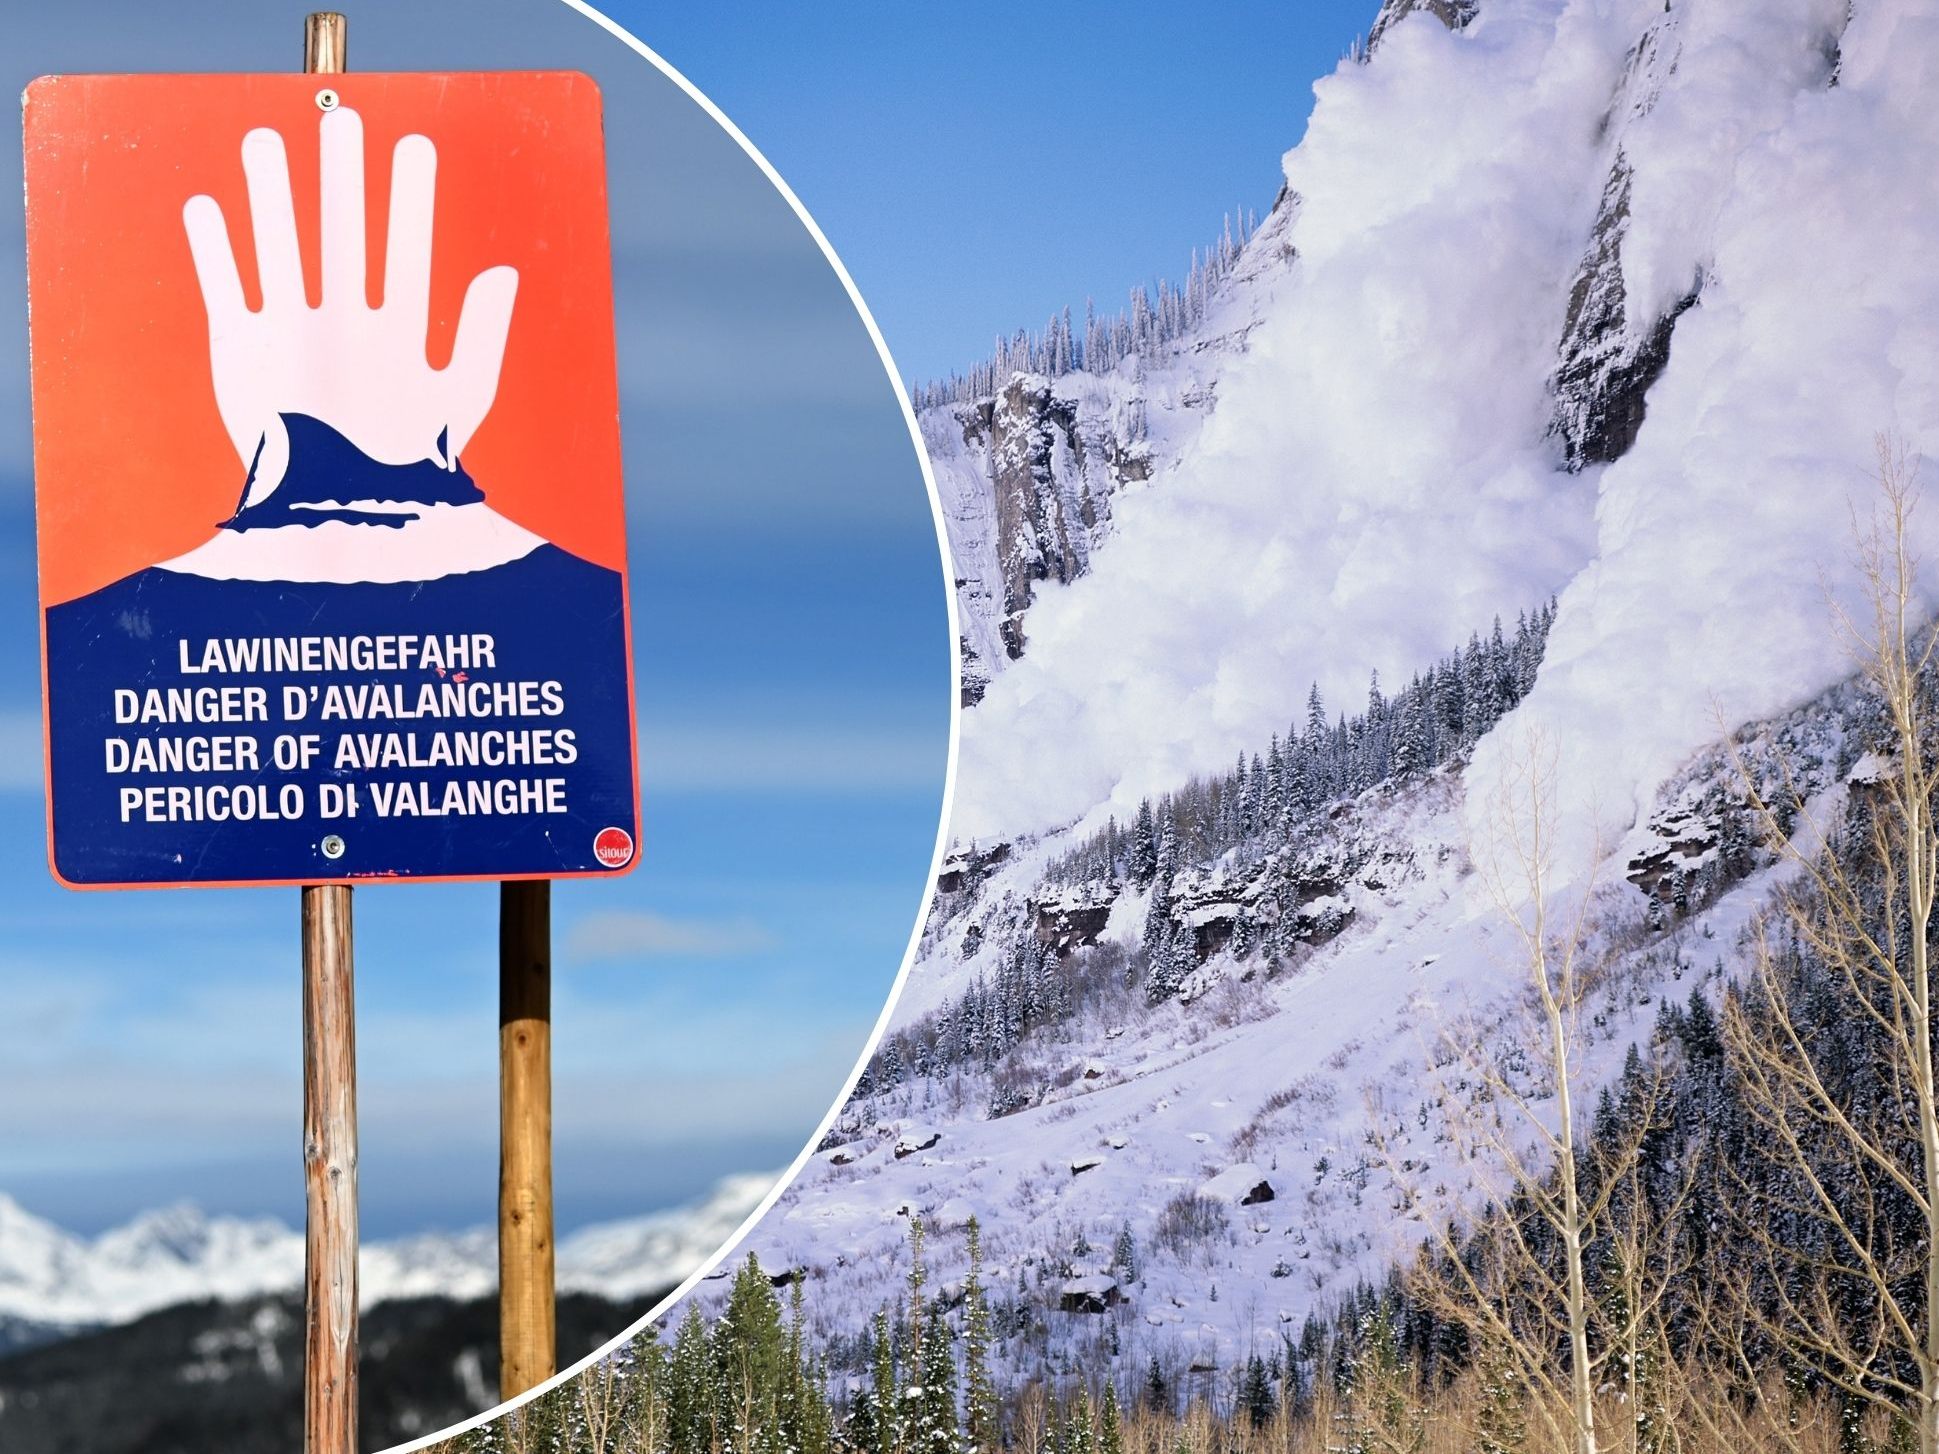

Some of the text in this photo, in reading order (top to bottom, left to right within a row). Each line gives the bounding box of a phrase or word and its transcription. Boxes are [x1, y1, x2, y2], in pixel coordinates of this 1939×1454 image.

[179, 634, 496, 674] LAWINENGEFAHR
[114, 681, 565, 725] DANGER D'AVALANCHES
[105, 729, 578, 774] DANGER OF AVALANCHES
[120, 778, 568, 823] PERICOLO DI VALANGHE
